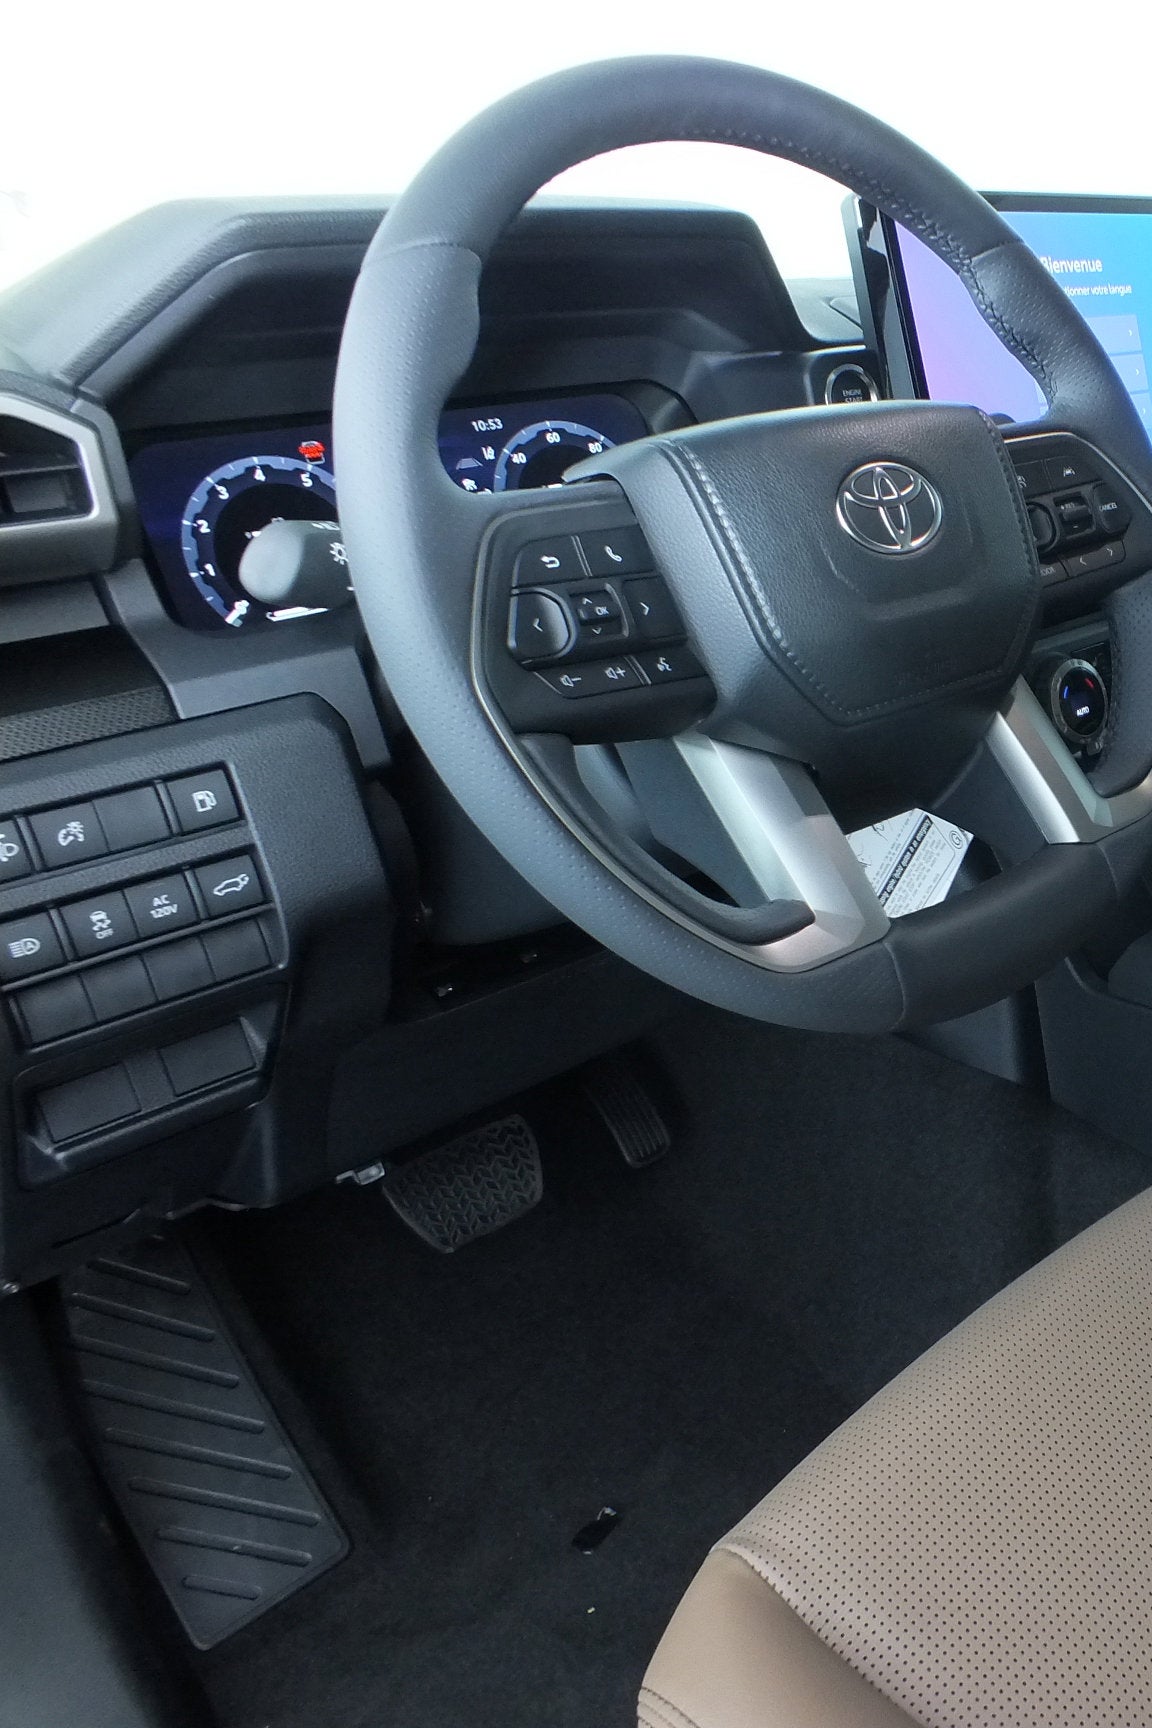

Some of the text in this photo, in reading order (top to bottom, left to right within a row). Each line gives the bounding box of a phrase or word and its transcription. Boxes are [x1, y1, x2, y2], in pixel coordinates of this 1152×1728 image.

[1064, 286, 1090, 297] tionner
[471, 418, 504, 432] 10:53
[546, 431, 561, 444] 60
[587, 441, 603, 454] 80
[511, 452, 527, 465] 40
[254, 467, 266, 482] 4
[300, 473, 313, 488] 5
[217, 486, 230, 500] 3
[196, 519, 211, 534] 2
[204, 563, 216, 577] 1
[152, 894, 170, 907] AC
[150, 904, 179, 919] 120V
[95, 928, 114, 940] OFF
